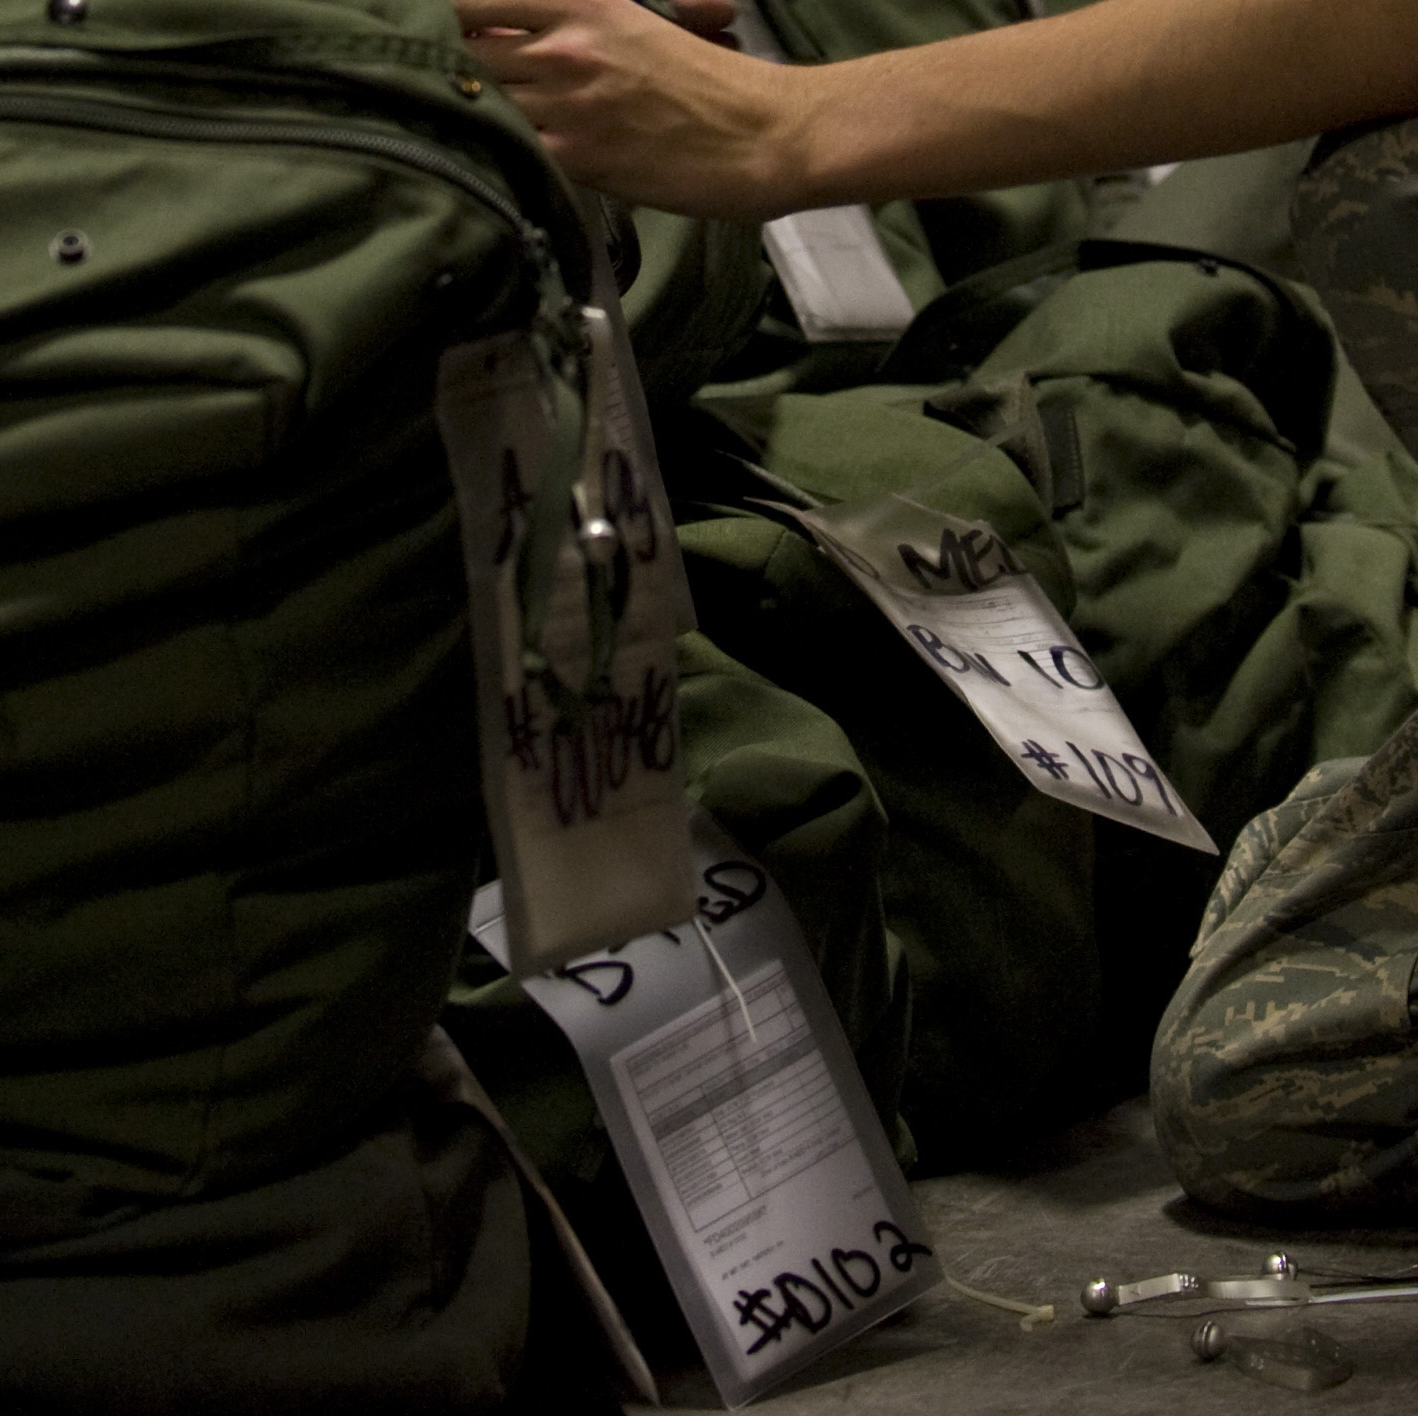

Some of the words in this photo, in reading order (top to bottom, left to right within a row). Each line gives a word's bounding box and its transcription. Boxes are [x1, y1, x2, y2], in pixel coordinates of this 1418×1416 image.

[1017, 648, 1106, 691] 10
[1020, 738, 1178, 817] #109
[734, 1220, 933, 1355] #D102
